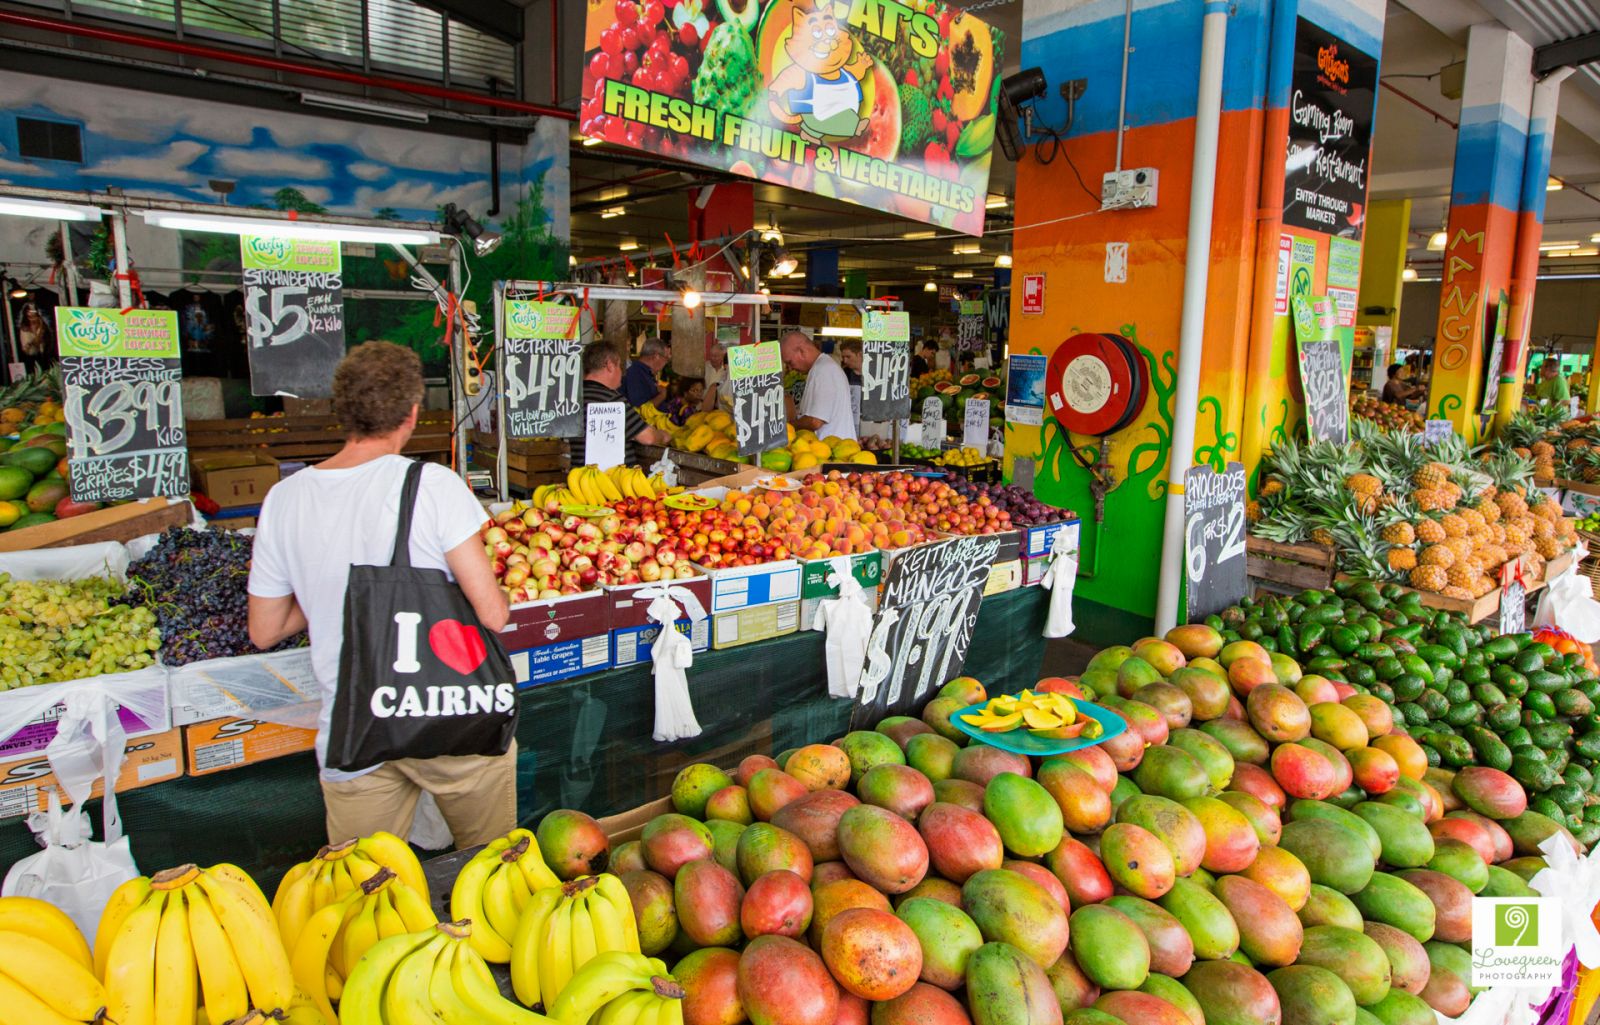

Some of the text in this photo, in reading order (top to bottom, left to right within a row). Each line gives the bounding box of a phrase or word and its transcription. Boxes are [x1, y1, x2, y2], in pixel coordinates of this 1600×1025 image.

[1293, 89, 1354, 143] Gaming Room
[604, 78, 976, 214] FRESH FRUIT & VEGETABLES
[1316, 147, 1364, 189] Restaurant
[1295, 187, 1348, 214] ENTRY THROUGH
[1305, 206, 1336, 226] MARKETS
[243, 269, 343, 290] STRAWBERRIES
[306, 293, 332, 306] EACH
[1439, 228, 1485, 370] MANGO
[245, 286, 309, 348] $5
[69, 317, 119, 345] rusty's
[505, 338, 582, 355] NECTARINES
[62, 357, 165, 373] SEEDLESS
[65, 368, 181, 386] GRAPES WHITE
[732, 373, 781, 393] PEACHES
[589, 406, 622, 416] BANANAS
[511, 420, 551, 436] WHITE
[72, 459, 114, 479] BLACK
[75, 467, 133, 491] GRAPES
[73, 490, 100, 501] WITH
[1185, 512, 1207, 583] 6
[883, 555, 996, 610] MANGOES
[393, 612, 422, 673] I
[859, 586, 974, 706] $1.99
[533, 651, 574, 664] Table Grapes
[533, 672, 552, 681] PRODUCE
[370, 683, 515, 718] CAIRNS
